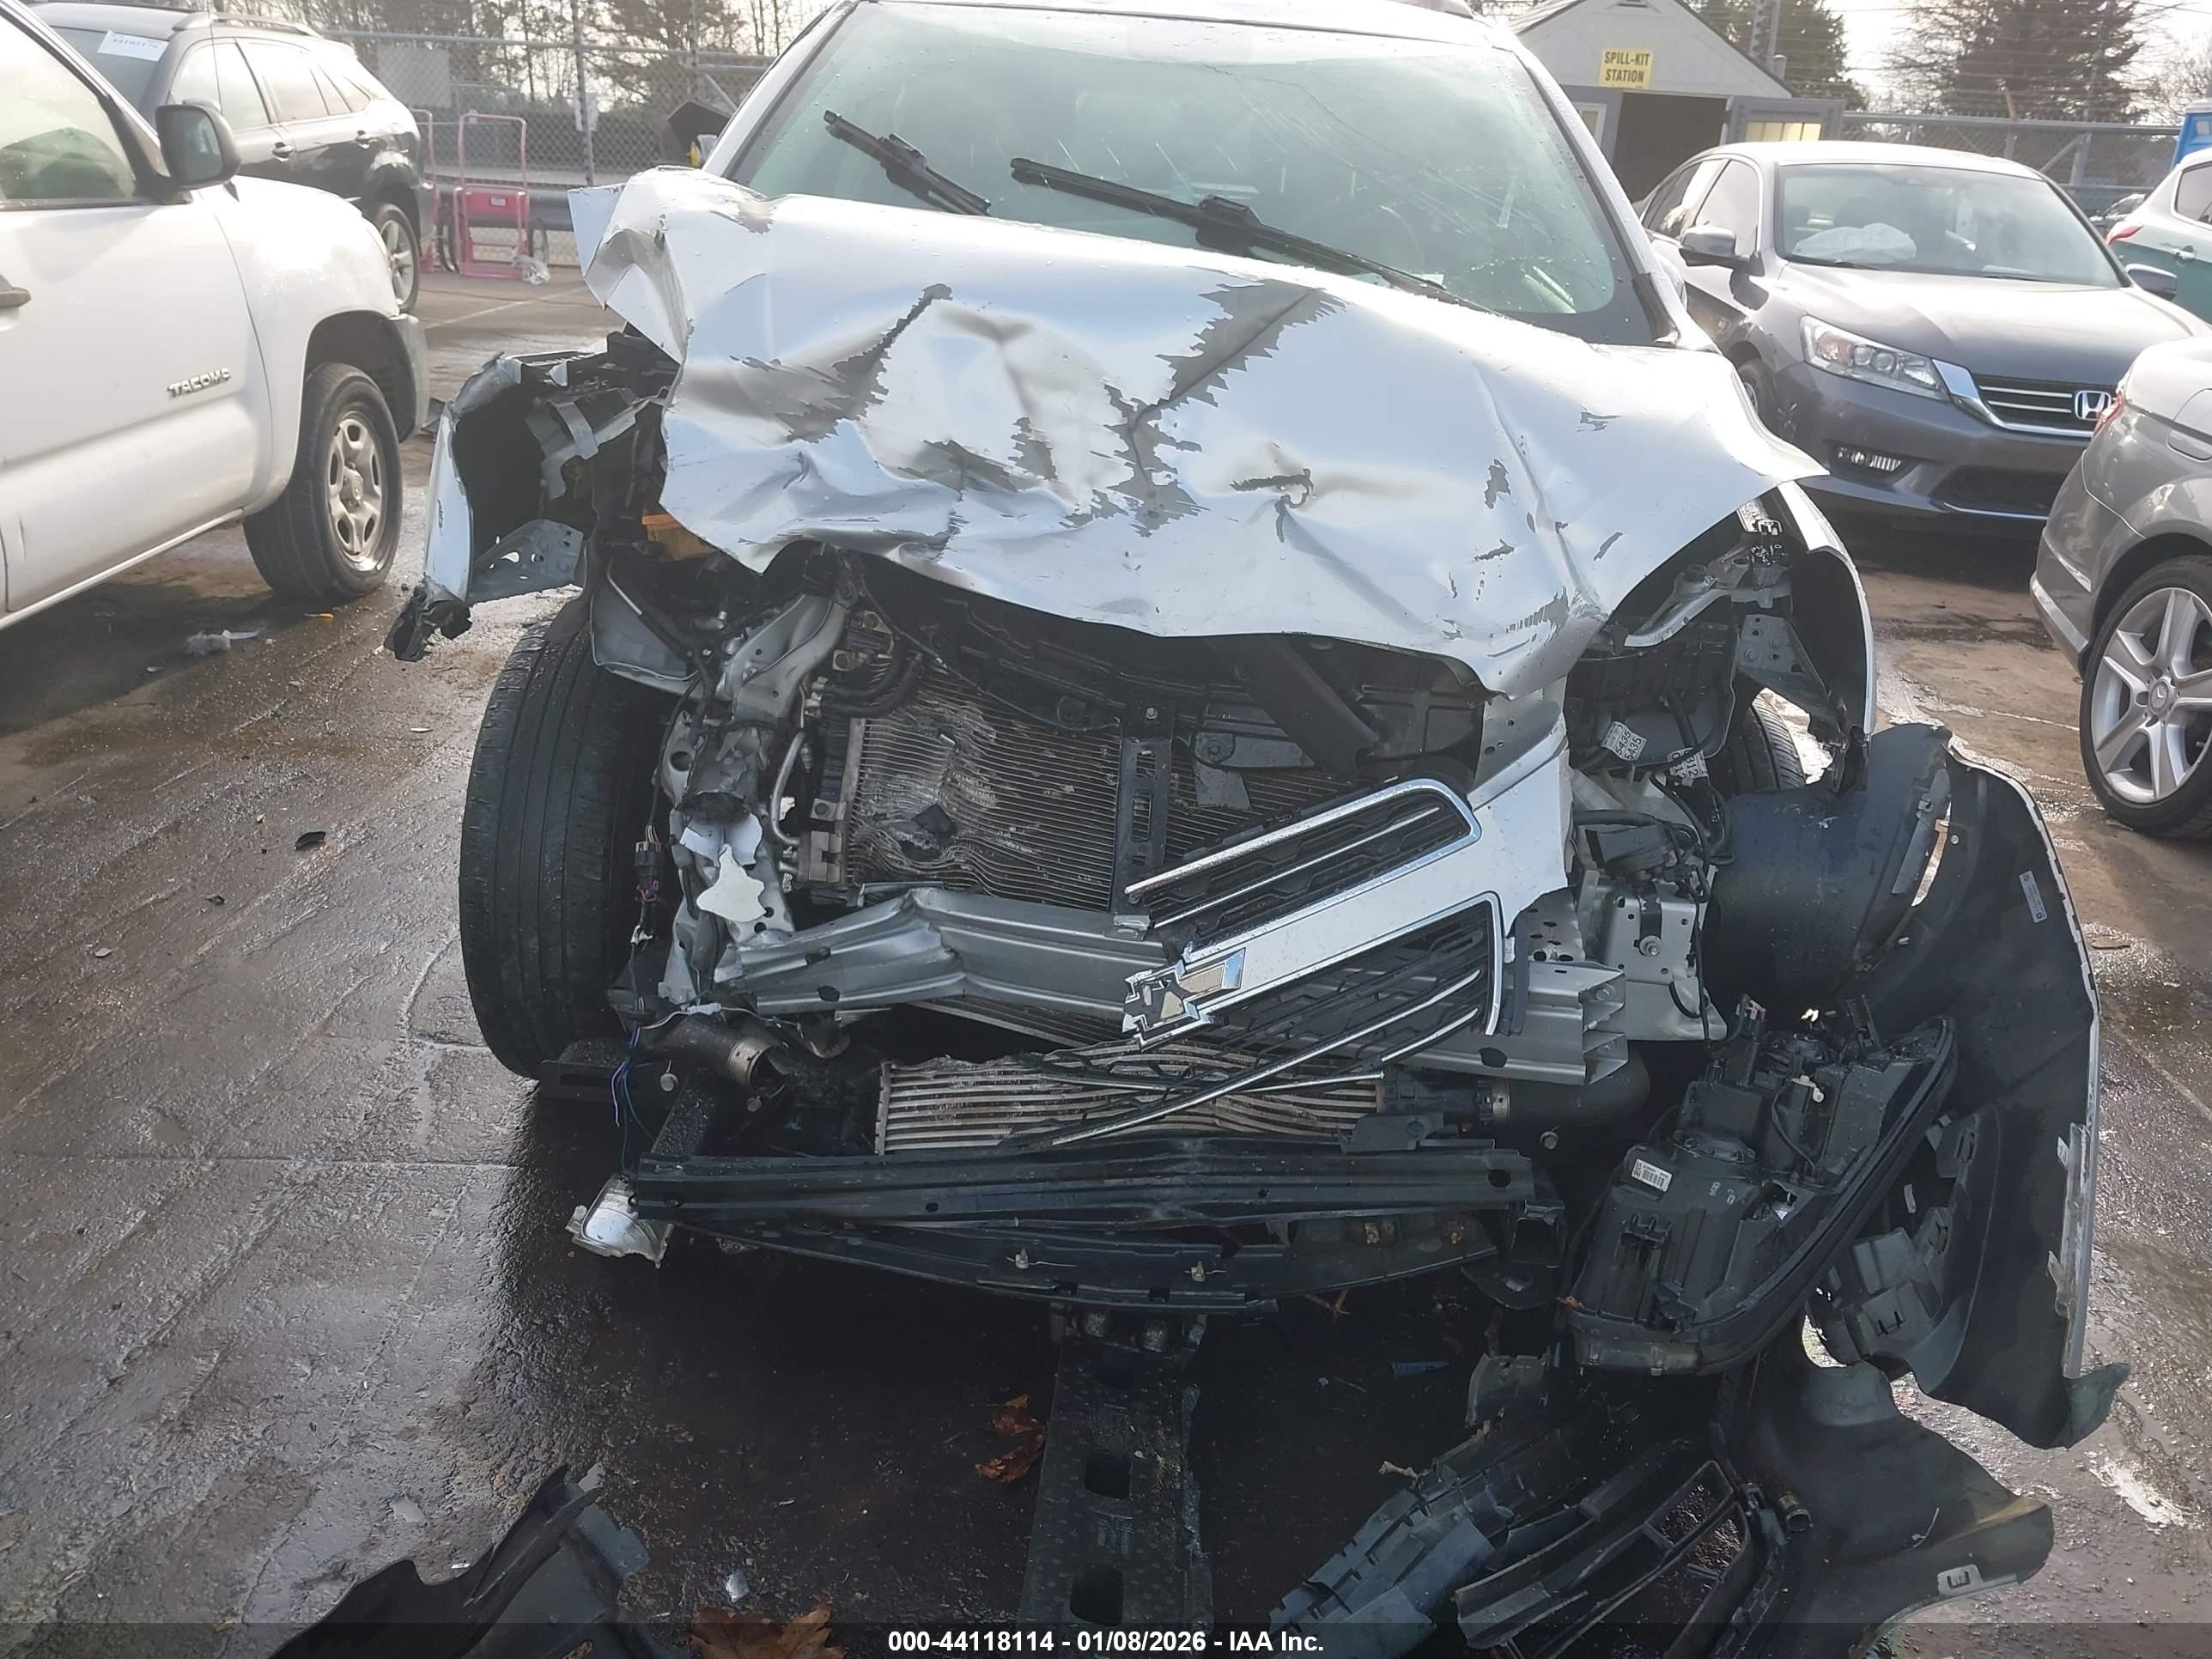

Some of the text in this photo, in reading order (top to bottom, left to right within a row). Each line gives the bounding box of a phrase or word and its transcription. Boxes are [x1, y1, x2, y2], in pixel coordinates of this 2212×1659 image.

[1604, 51, 1650, 66] SPILL-KIT
[1605, 69, 1645, 83] STATION
[167, 368, 230, 396] TACOMA
[1614, 730, 1632, 756] 5435
[1624, 738, 1642, 760] 5435
